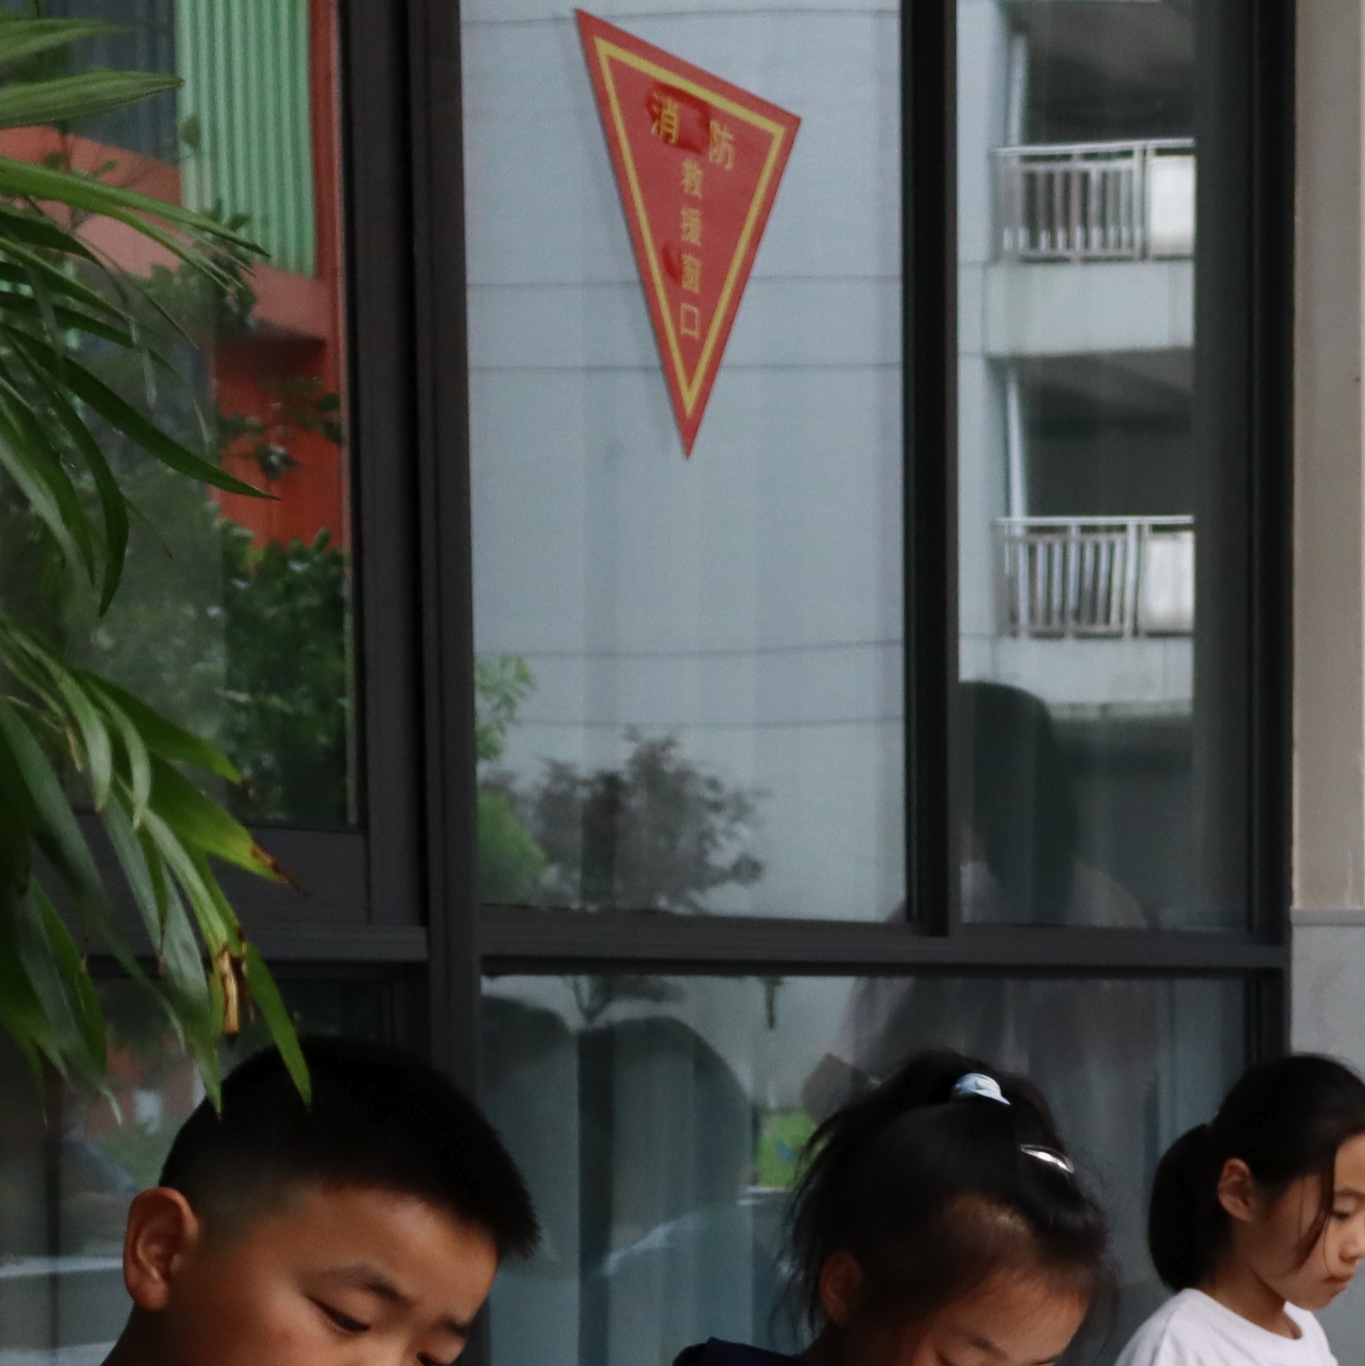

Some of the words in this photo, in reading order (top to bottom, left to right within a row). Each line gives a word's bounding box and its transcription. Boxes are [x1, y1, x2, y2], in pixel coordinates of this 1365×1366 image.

[650, 92, 736, 172] 消防
[680, 157, 704, 340] 救援窗口
